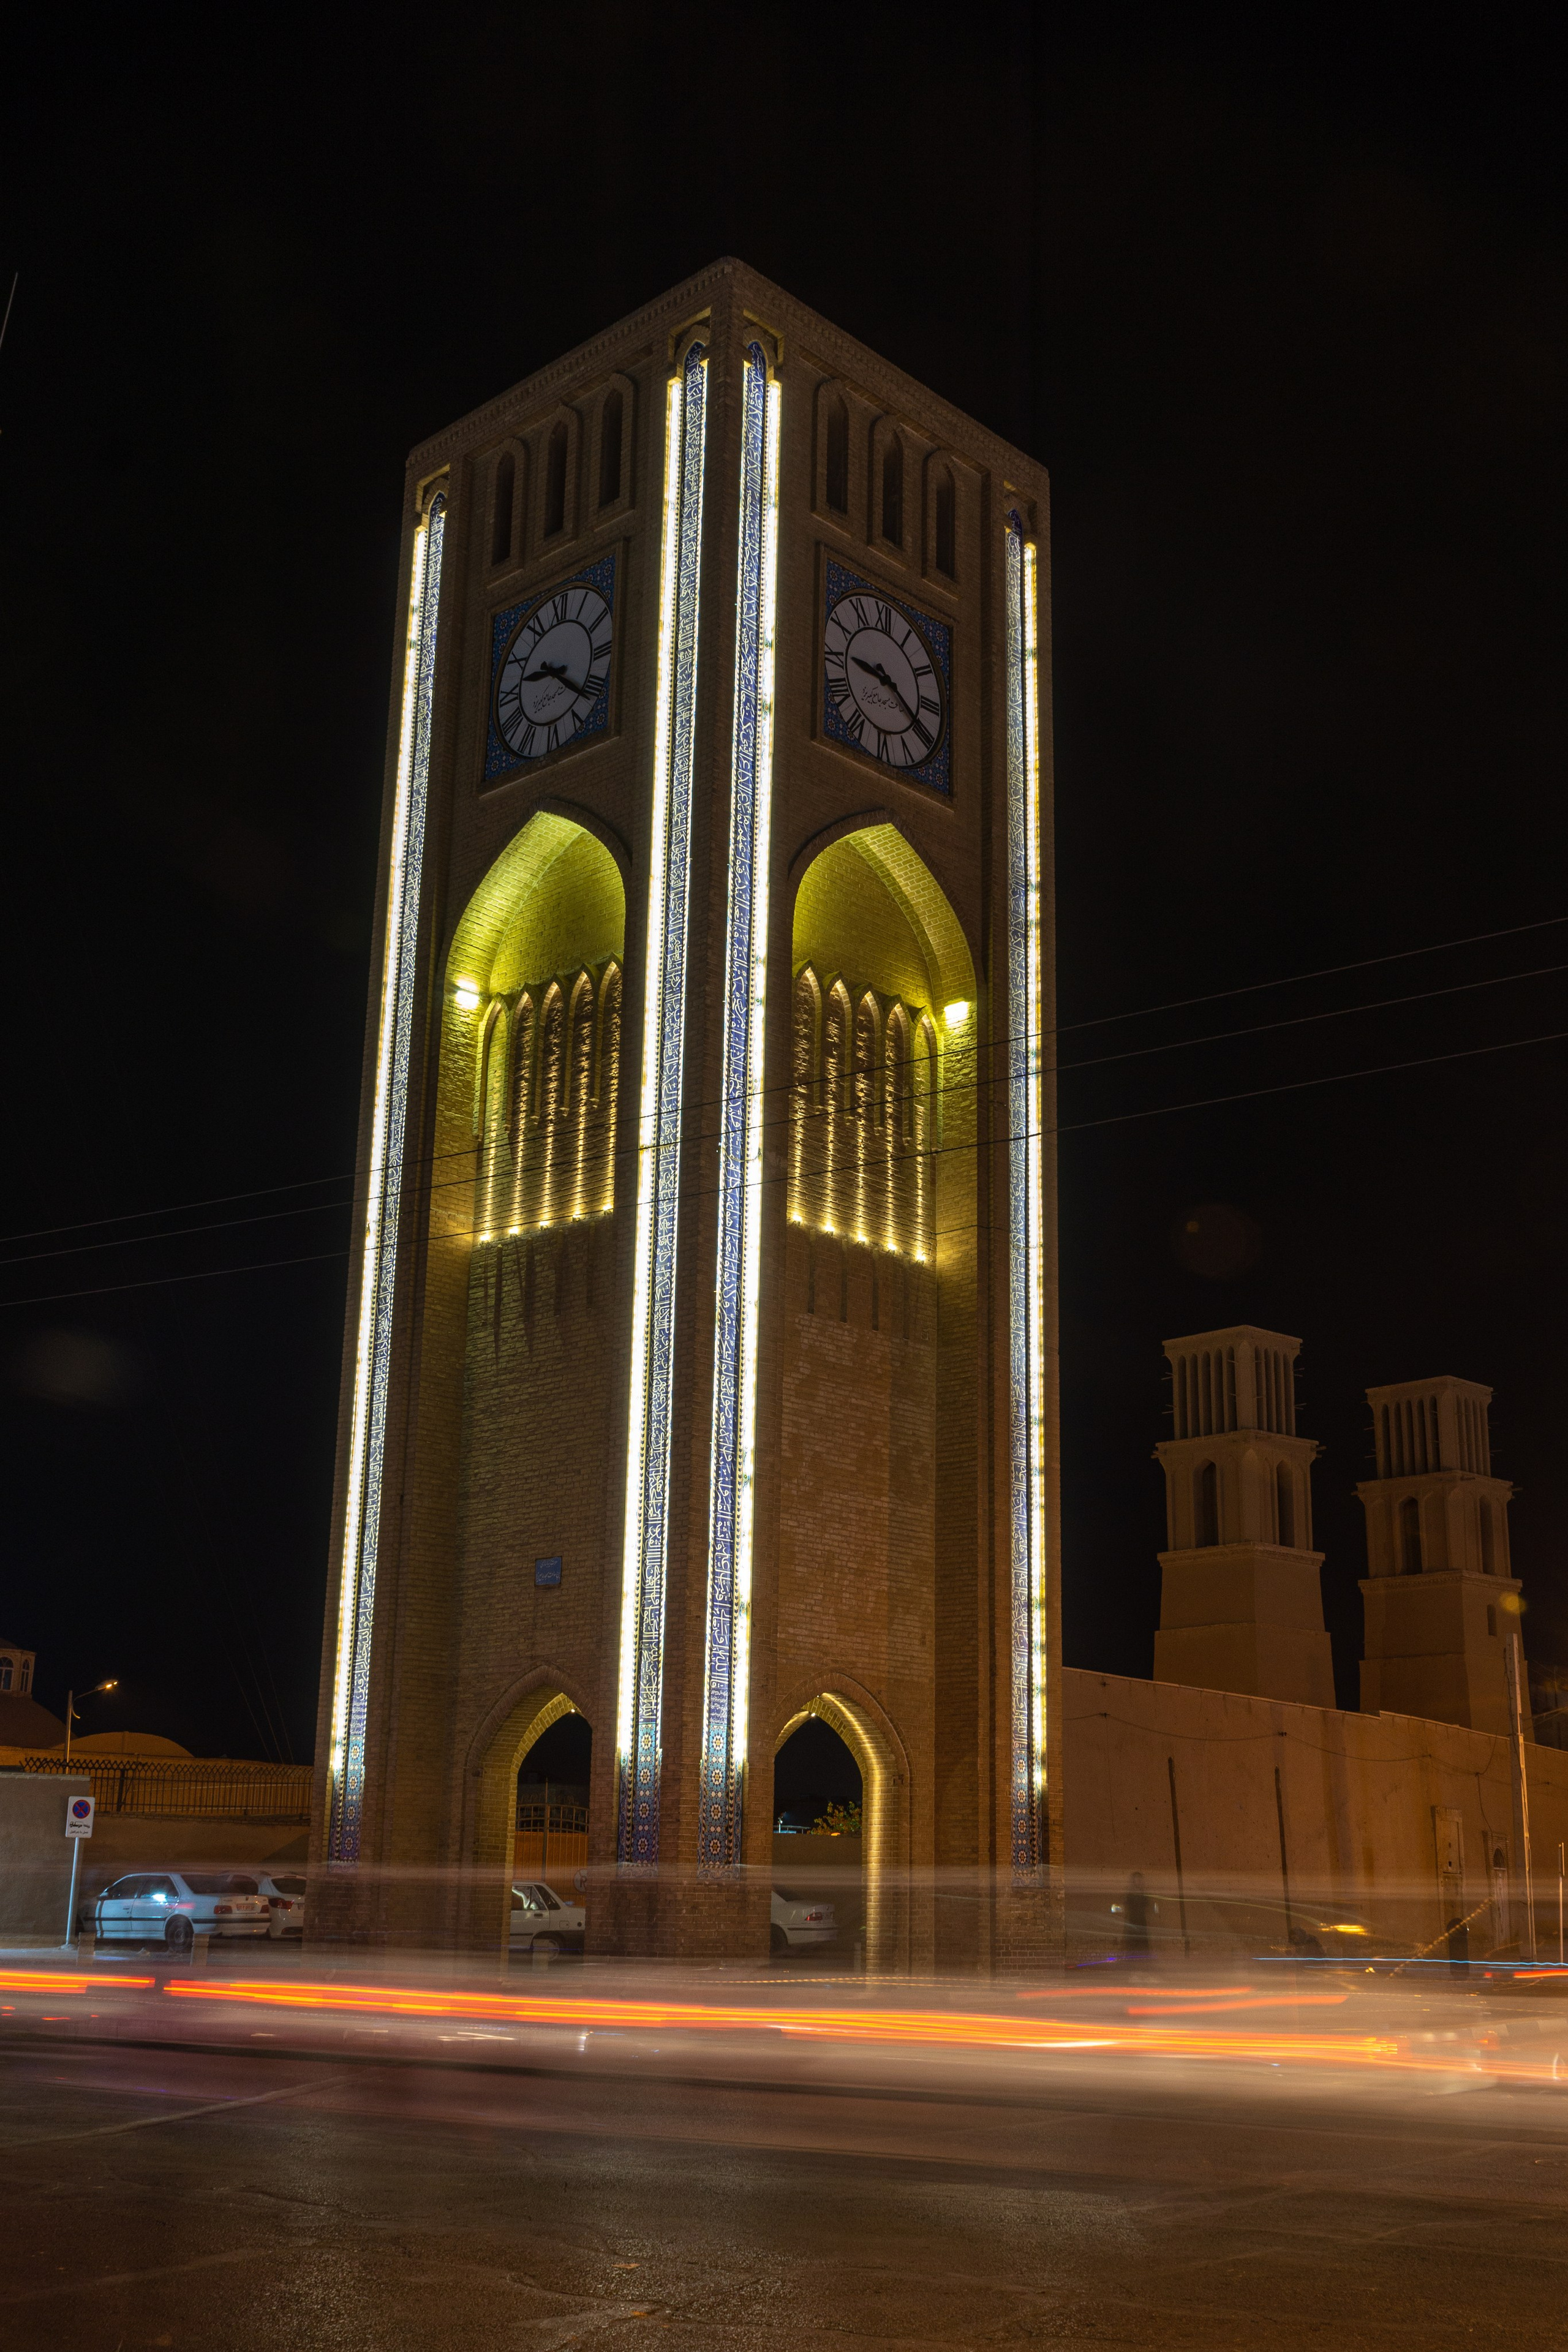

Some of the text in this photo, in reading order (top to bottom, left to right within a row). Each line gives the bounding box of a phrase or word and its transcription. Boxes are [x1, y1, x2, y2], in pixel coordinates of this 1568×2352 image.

[551, 593, 568, 627] XII
[576, 592, 589, 619] I
[849, 598, 870, 628] XI
[875, 601, 891, 635] XII
[527, 614, 545, 645] XI
[589, 608, 608, 633] II
[830, 611, 851, 641] X
[594, 641, 611, 660] III
[901, 629, 912, 647] I
[508, 651, 527, 669] X
[825, 643, 844, 668] IX
[914, 664, 933, 678] II
[499, 684, 519, 707] IX
[829, 678, 850, 709] VIII
[921, 695, 939, 716] III
[502, 707, 523, 742] VIII
[571, 709, 584, 731] V
[847, 710, 865, 741] VII
[518, 725, 536, 755] VII
[547, 726, 559, 752] VI
[877, 731, 891, 763] VI
[901, 736, 914, 764] V
